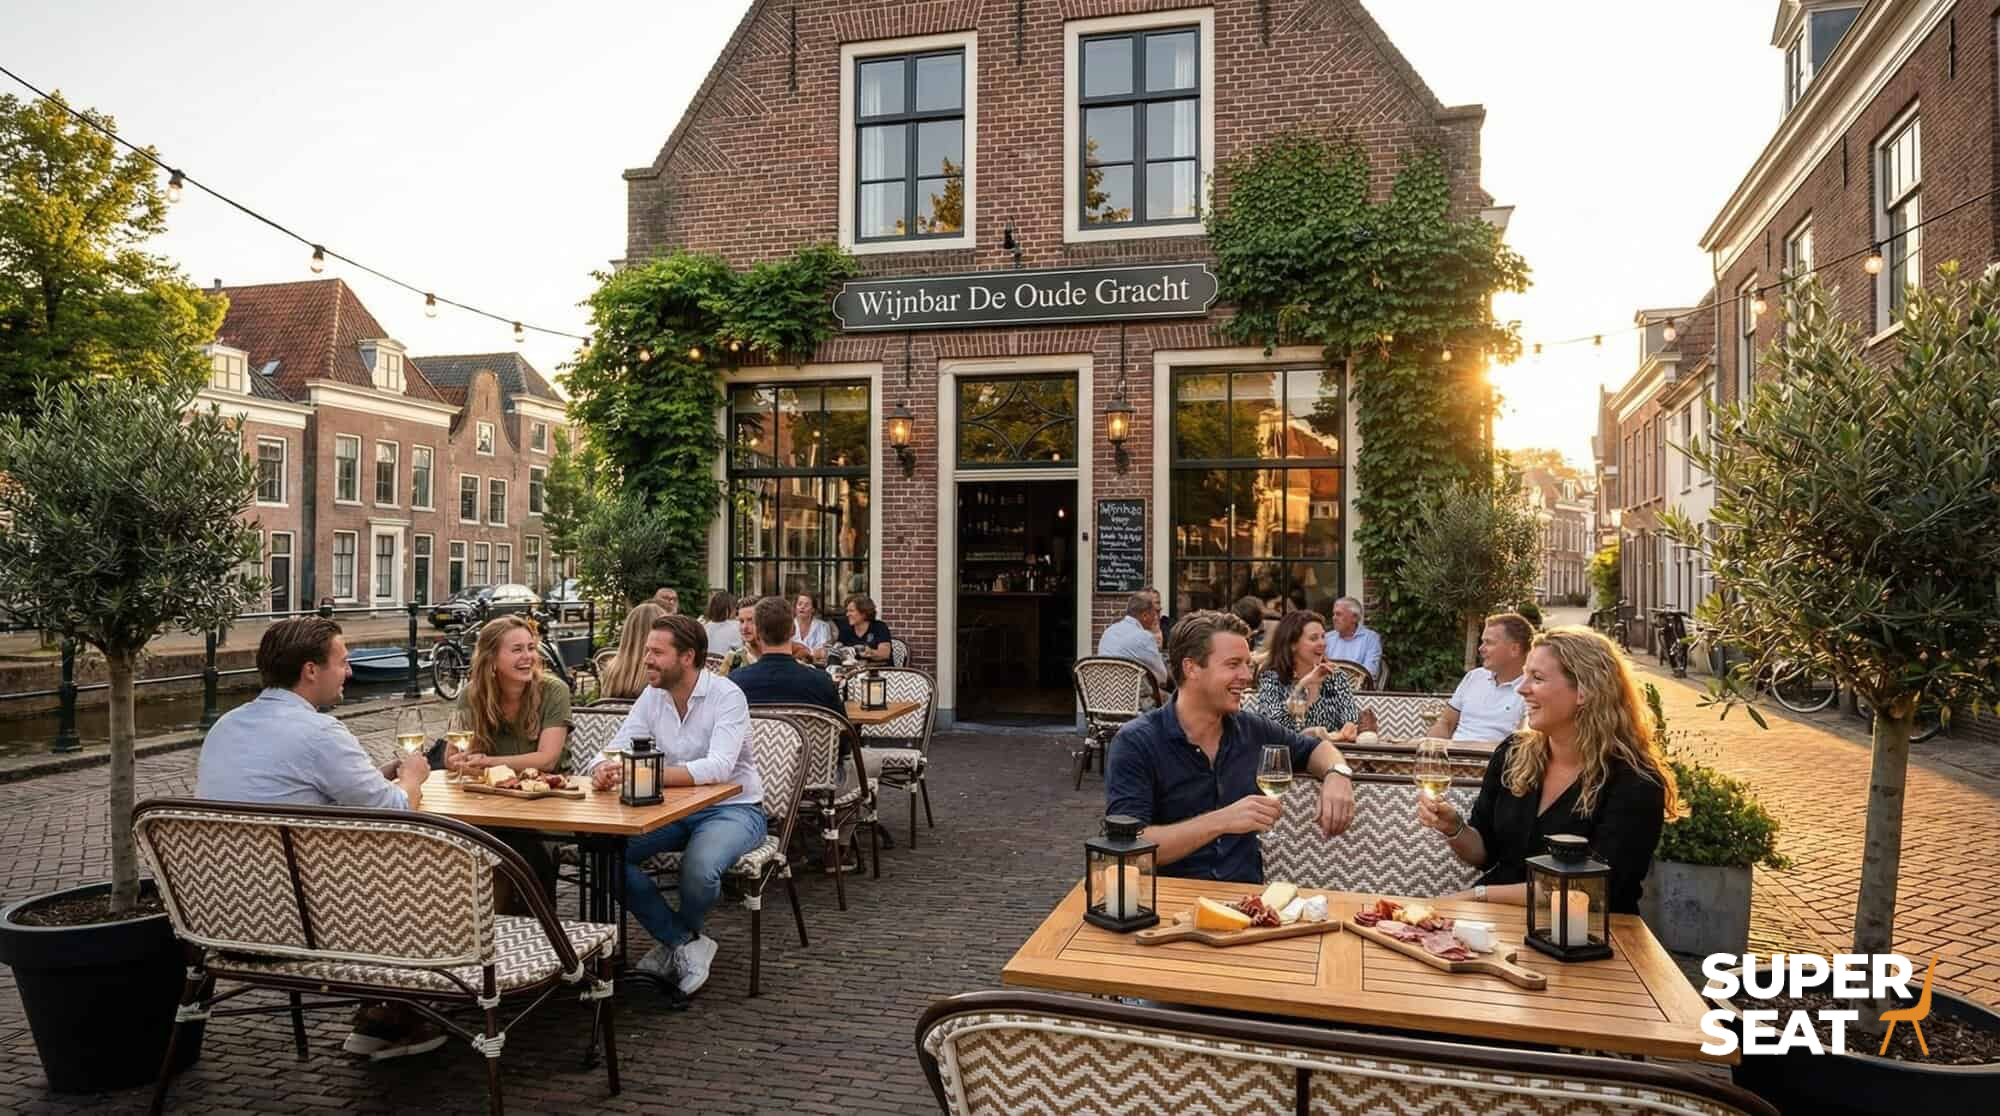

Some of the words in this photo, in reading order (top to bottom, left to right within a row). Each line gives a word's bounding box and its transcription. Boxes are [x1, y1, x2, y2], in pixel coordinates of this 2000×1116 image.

[857, 288, 961, 320] Wijnbar
[967, 285, 1007, 311] De
[1014, 281, 1087, 308] Oude
[1095, 275, 1190, 305] Gracht
